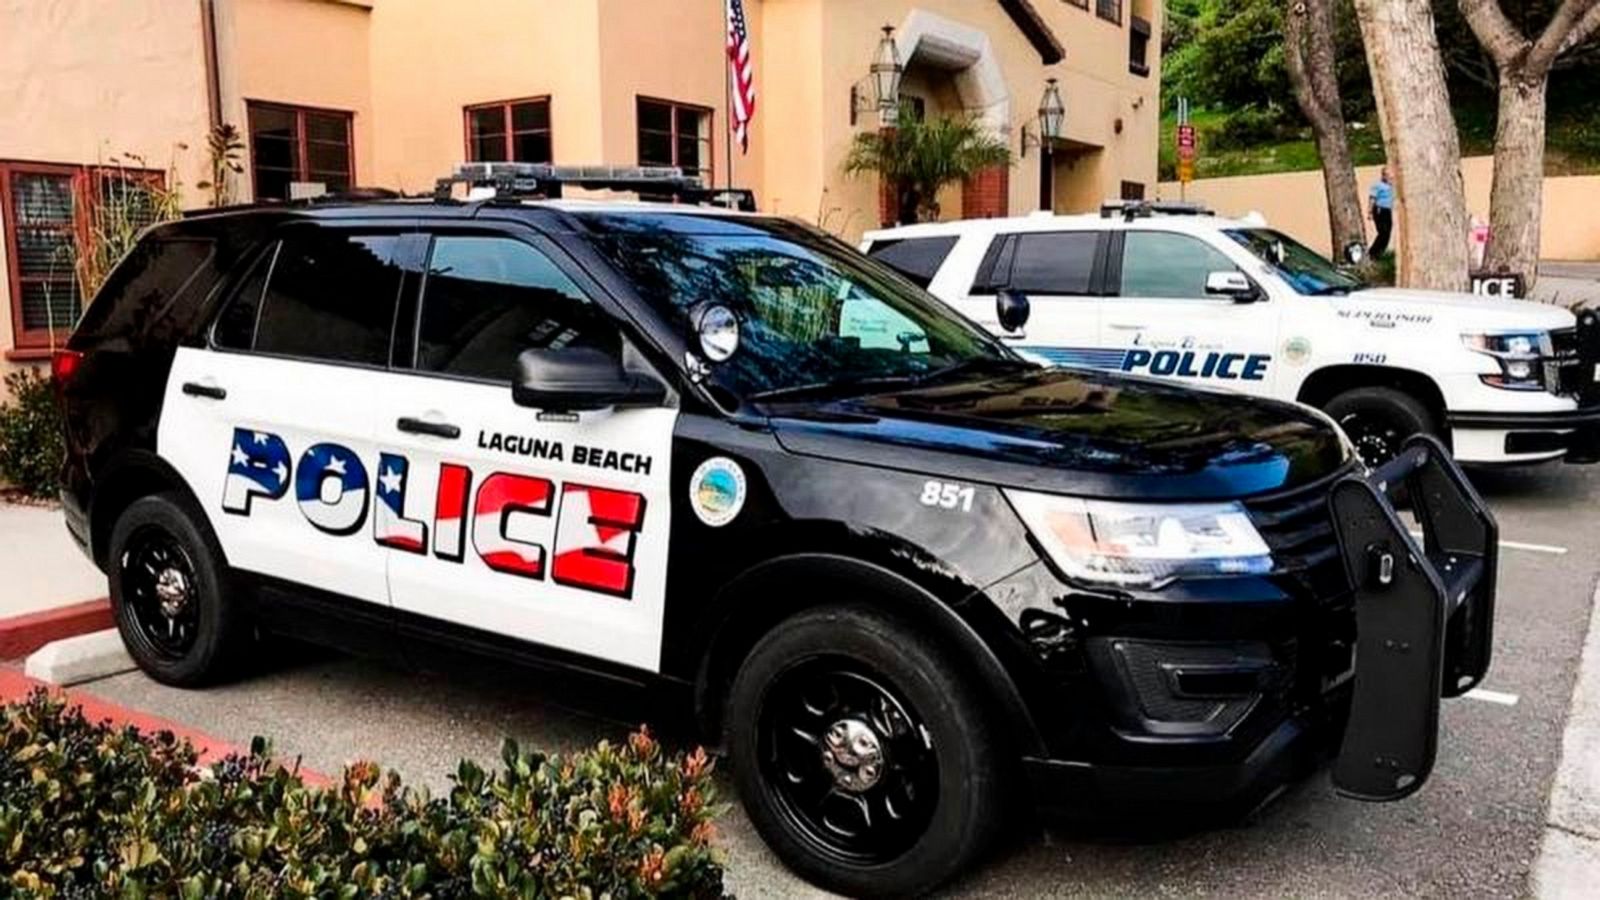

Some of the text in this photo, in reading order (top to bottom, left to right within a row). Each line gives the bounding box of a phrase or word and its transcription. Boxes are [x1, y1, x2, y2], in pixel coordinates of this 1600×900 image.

[1473, 277, 1516, 299] ICE
[1121, 349, 1272, 380] POLICE
[477, 430, 652, 476] LAGUNA BEACH
[921, 481, 975, 512] 851
[222, 426, 648, 600] POLICE
